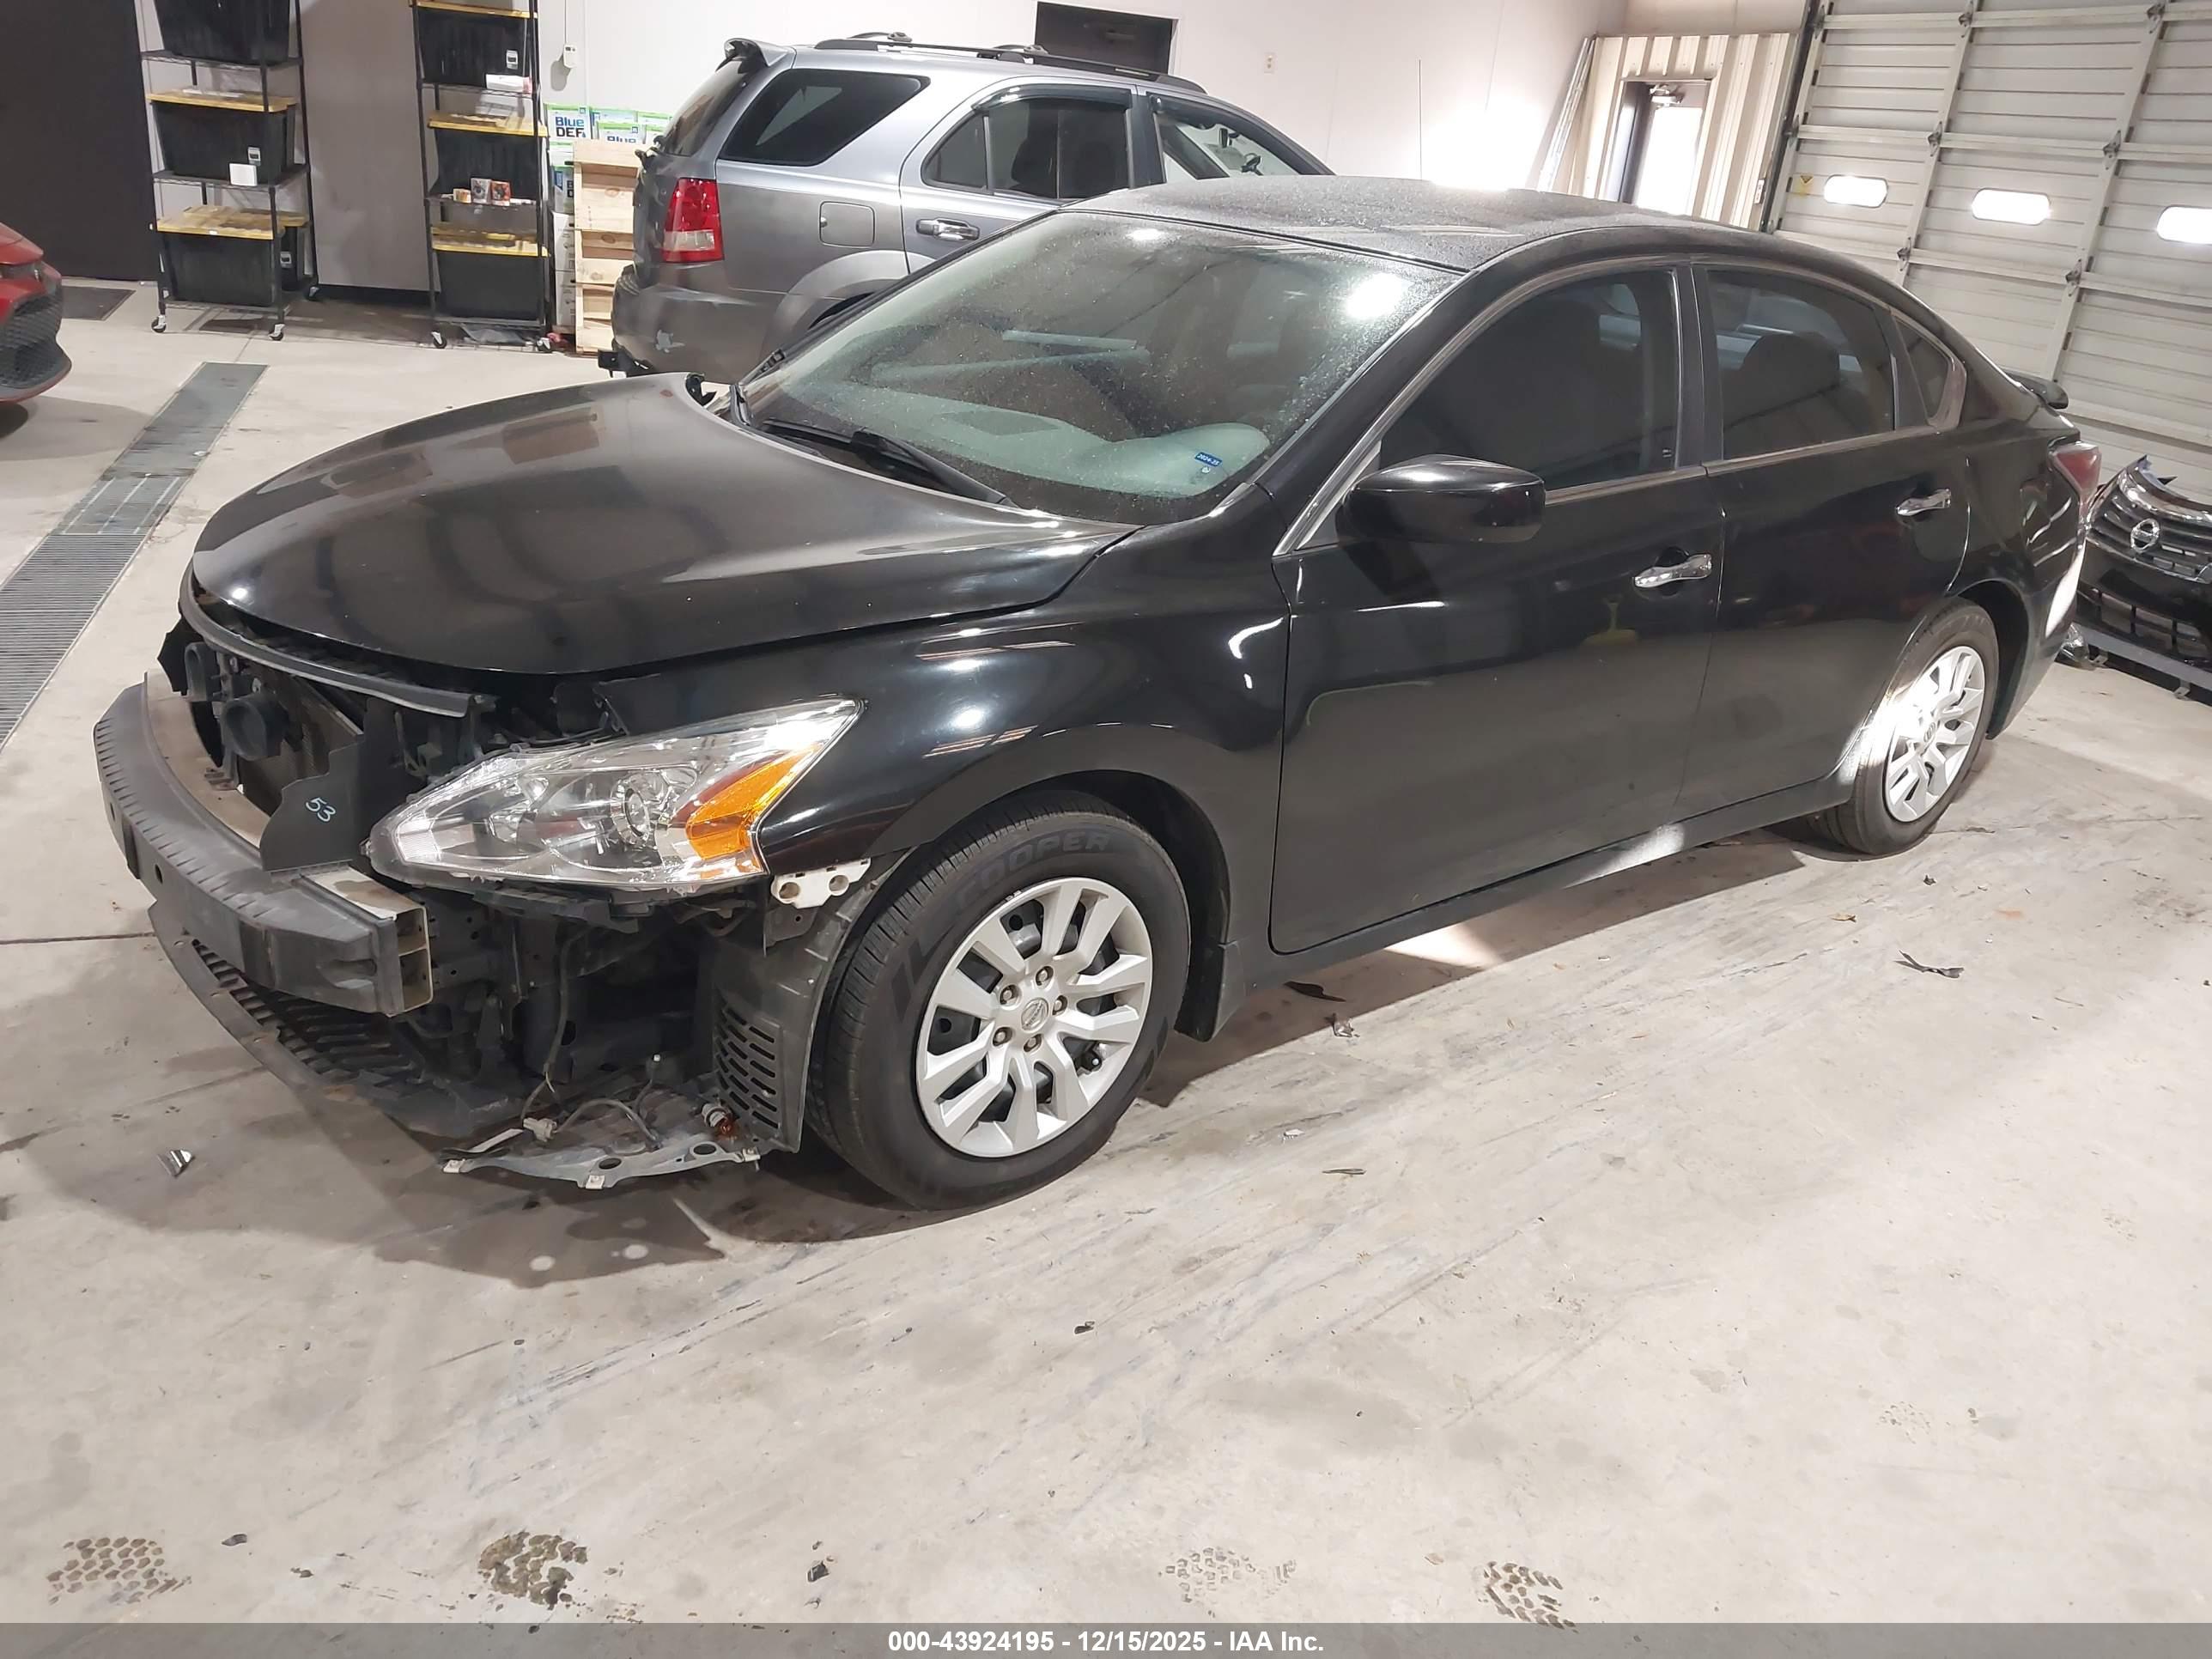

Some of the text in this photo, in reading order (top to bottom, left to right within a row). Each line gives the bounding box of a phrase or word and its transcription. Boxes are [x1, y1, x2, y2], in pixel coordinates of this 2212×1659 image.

[556, 117, 585, 127] Blue
[556, 127, 585, 137] DEF
[306, 797, 336, 822] 53
